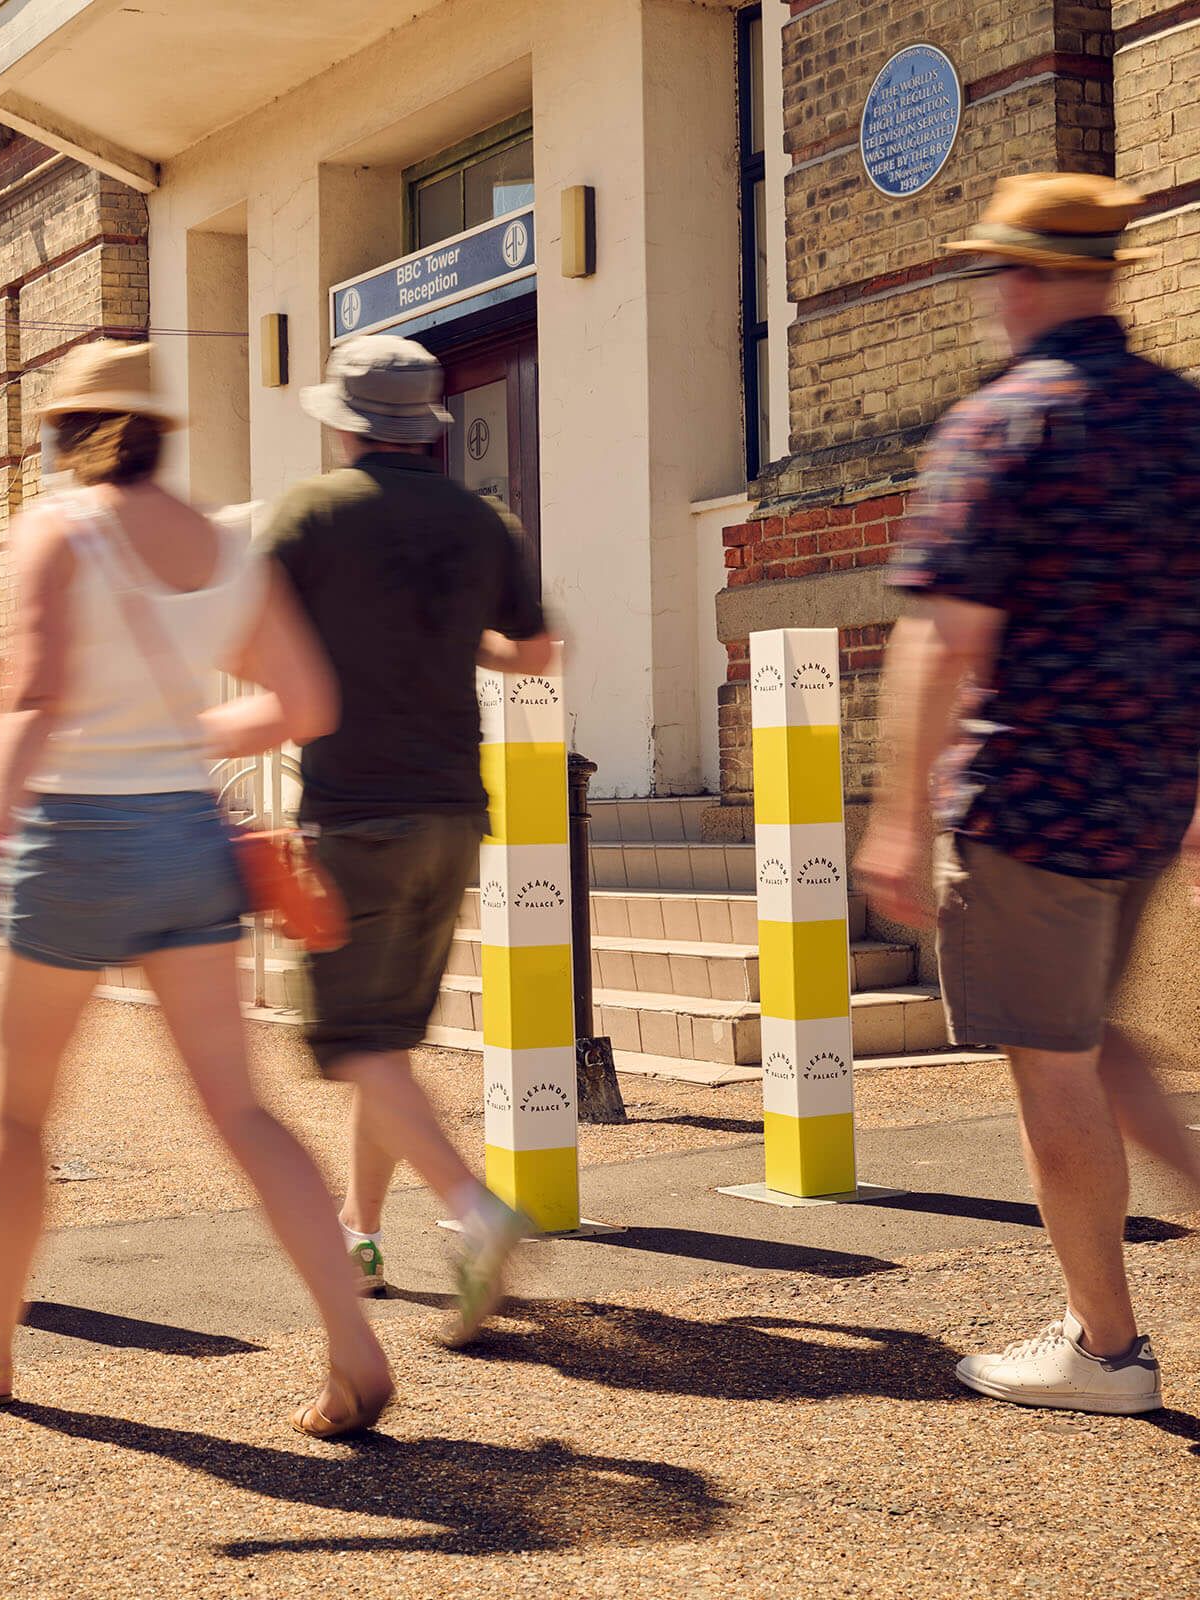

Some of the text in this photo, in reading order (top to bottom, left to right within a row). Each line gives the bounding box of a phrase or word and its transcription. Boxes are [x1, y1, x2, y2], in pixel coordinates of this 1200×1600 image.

[873, 81, 945, 118] FIRST REGULAR
[880, 84, 898, 101] THE
[869, 93, 950, 134] HIGH DEFINITION
[864, 106, 956, 150] TELEVISION SERVICE
[865, 123, 954, 163] WAS INAUGURATED
[871, 138, 950, 177] HERE BY THE BBC
[894, 161, 933, 181] November
[900, 176, 919, 191] 1936
[396, 247, 461, 286] BBC Tower
[399, 271, 459, 307] Reception
[790, 662, 834, 688] ALEXANDRA
[510, 677, 559, 703] ALEXANDRA
[796, 857, 840, 884] ALEXANDRA
[514, 879, 564, 907] ALEXANDRA
[803, 1052, 848, 1079] ALEXANDRA
[813, 1072, 838, 1080] PALACE
[520, 1083, 570, 1111] ALEXANDRA
[530, 1104, 560, 1112] PALACE
